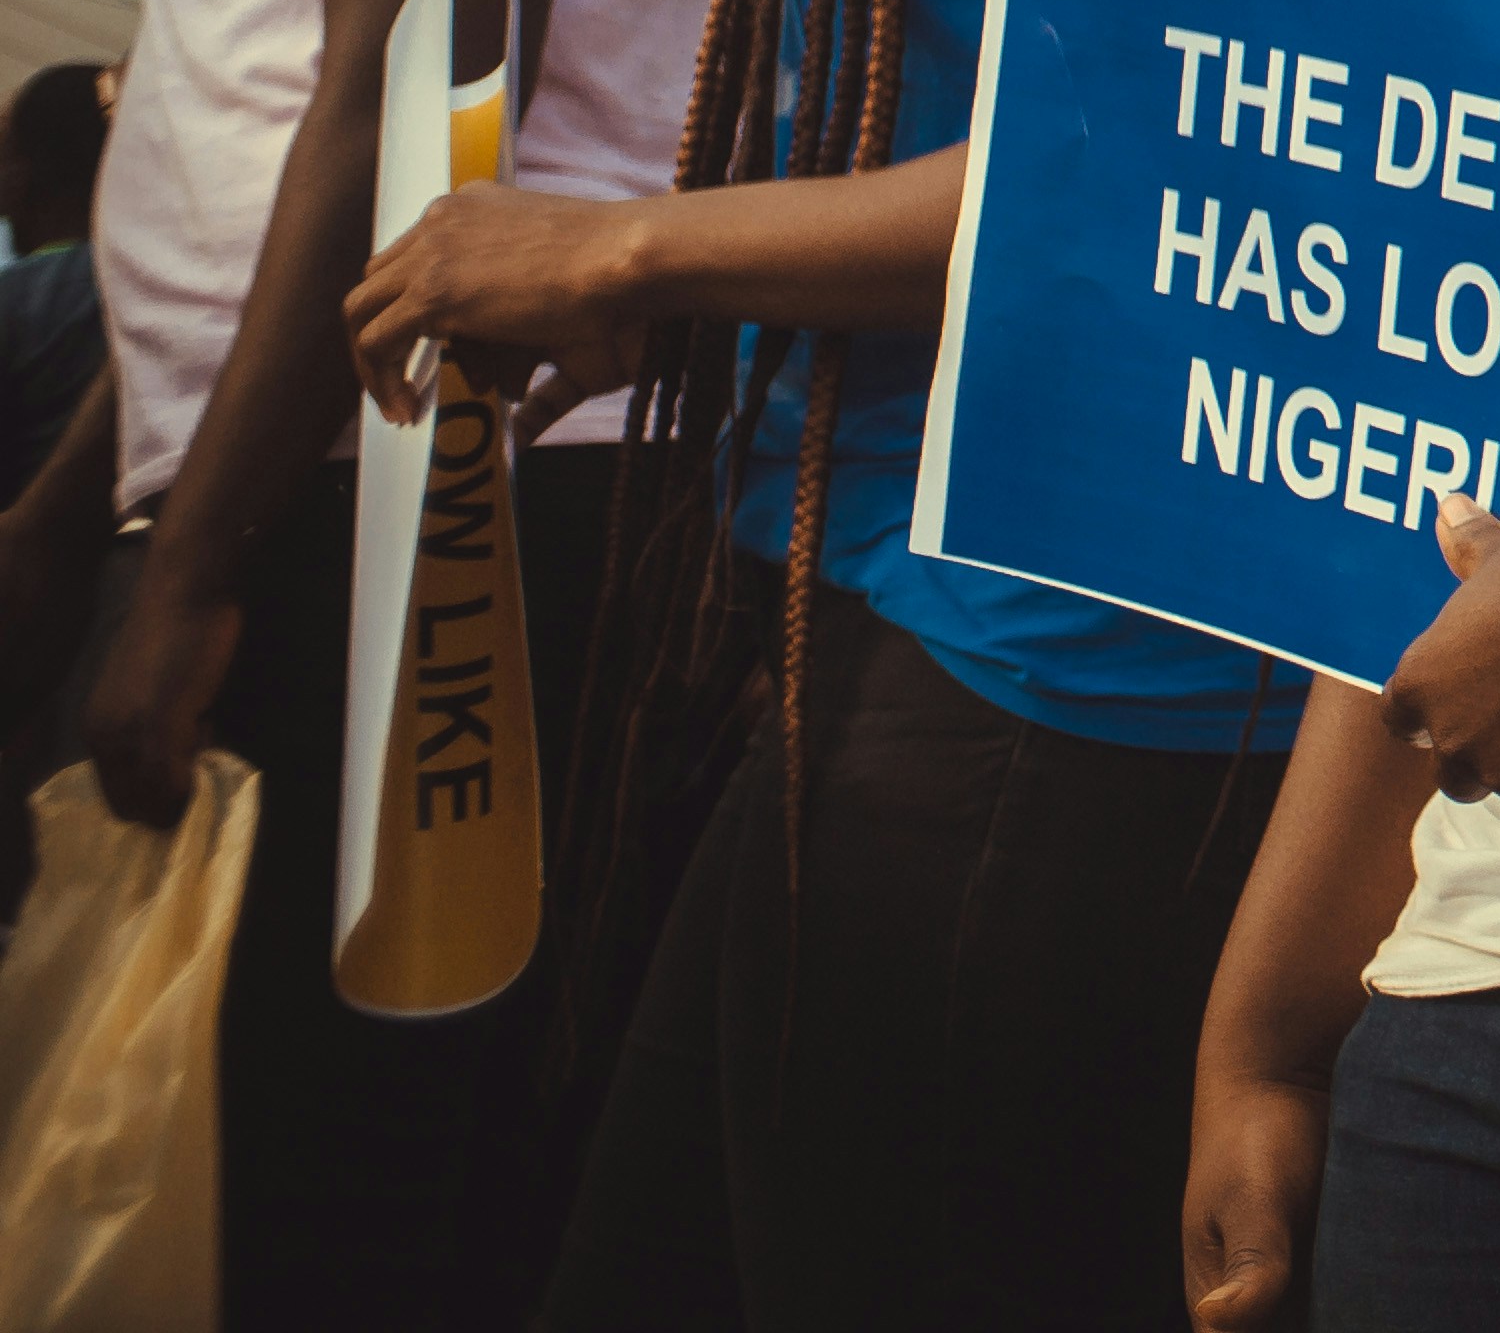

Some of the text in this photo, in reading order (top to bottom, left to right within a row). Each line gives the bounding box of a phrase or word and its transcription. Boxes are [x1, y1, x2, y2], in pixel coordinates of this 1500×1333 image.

[1165, 27, 1348, 171] THE
[1154, 188, 1347, 335] HAS
[416, 349, 494, 831] OW LIKE
